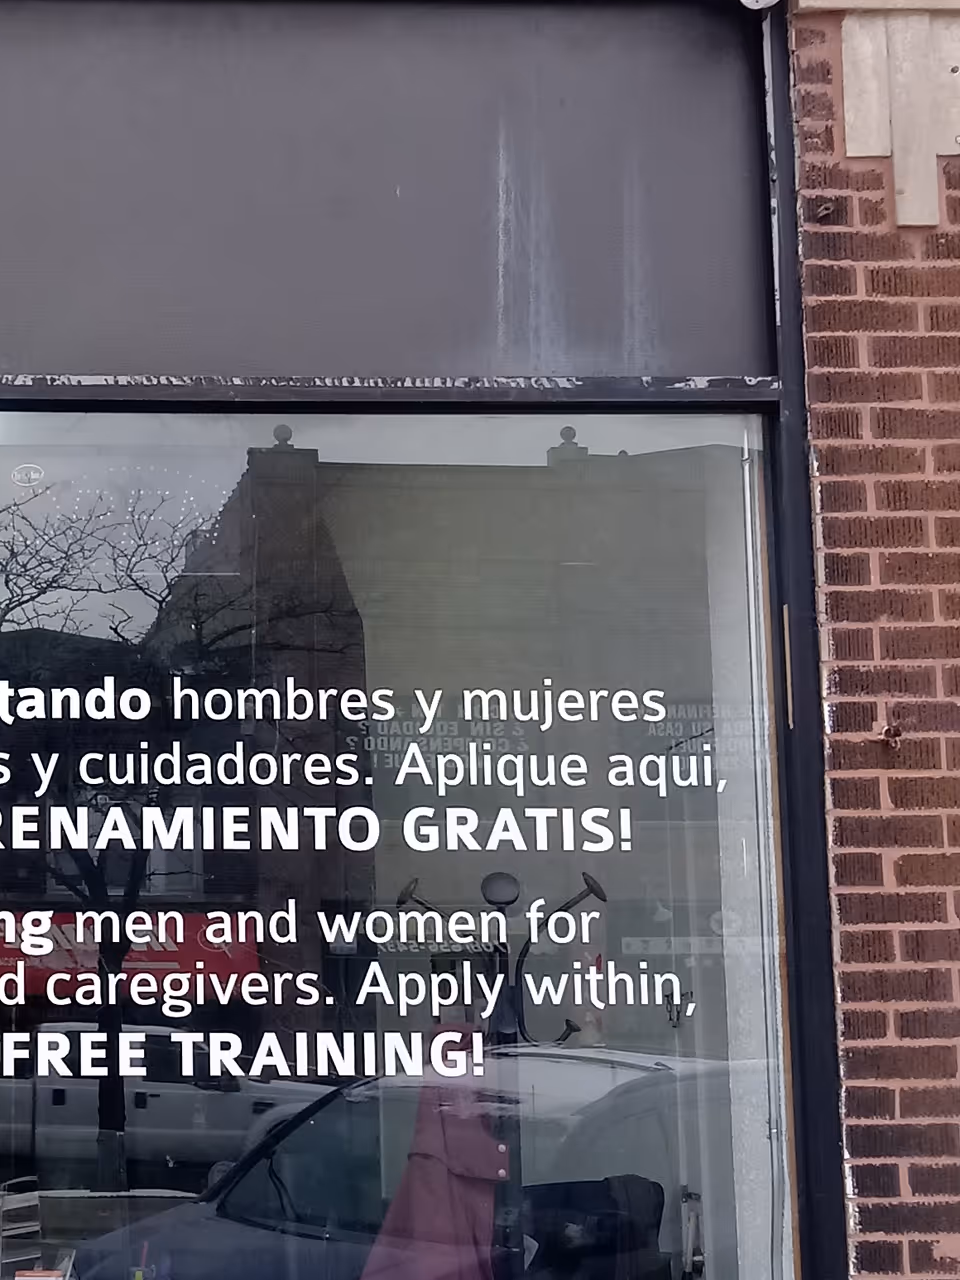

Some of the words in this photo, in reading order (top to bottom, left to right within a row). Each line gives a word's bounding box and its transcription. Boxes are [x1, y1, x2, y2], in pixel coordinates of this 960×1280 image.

[172, 675, 395, 721] hombres
[413, 690, 443, 733] y
[462, 677, 666, 733] mujeres
[30, 753, 59, 798] y
[78, 740, 373, 786] cuidadores.
[394, 742, 588, 797] Aplique
[607, 742, 727, 797] aqui,
[403, 805, 633, 852] GRATIS!
[75, 911, 184, 944] men
[205, 897, 297, 944] and
[317, 911, 507, 944] women
[525, 897, 600, 944] for
[45, 960, 334, 1018] caregivers.
[355, 959, 505, 1018] Apply
[524, 959, 697, 1017] within,
[2, 1031, 147, 1077] FREE
[170, 1030, 485, 1077] TRAINING!
